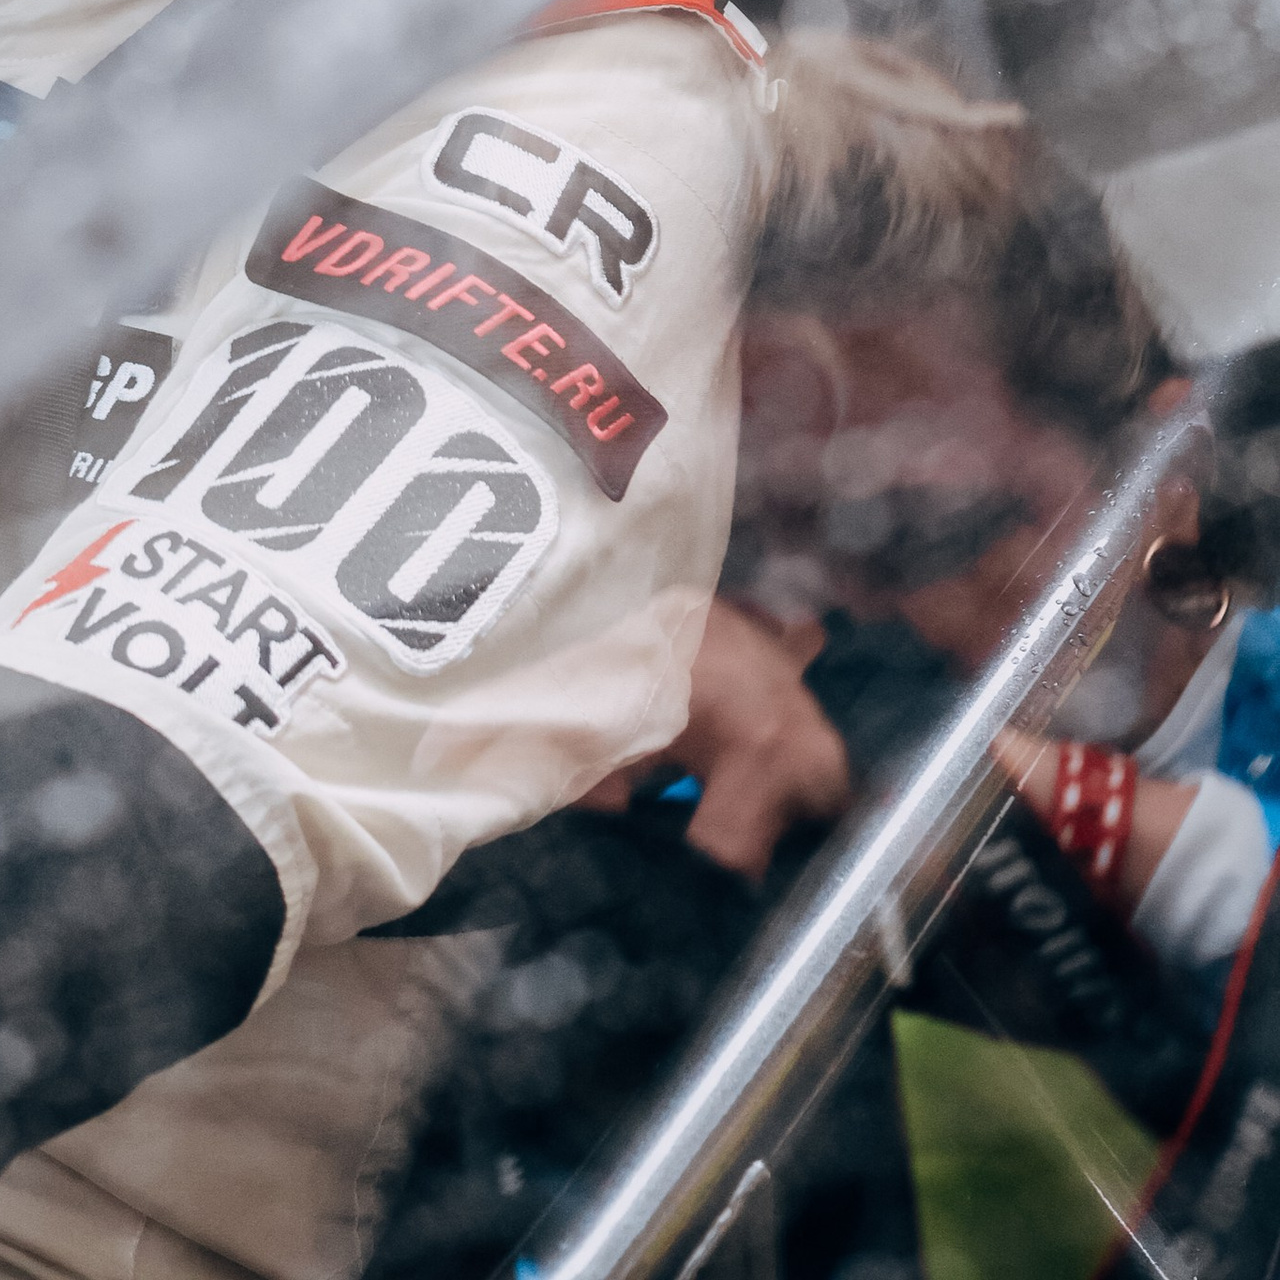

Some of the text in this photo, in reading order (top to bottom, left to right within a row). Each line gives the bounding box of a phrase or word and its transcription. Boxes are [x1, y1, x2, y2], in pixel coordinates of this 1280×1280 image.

[433, 113, 653, 296] CR
[281, 215, 635, 442] VDRIFTE.RU
[128, 320, 542, 652] 100
[120, 530, 339, 688] START
